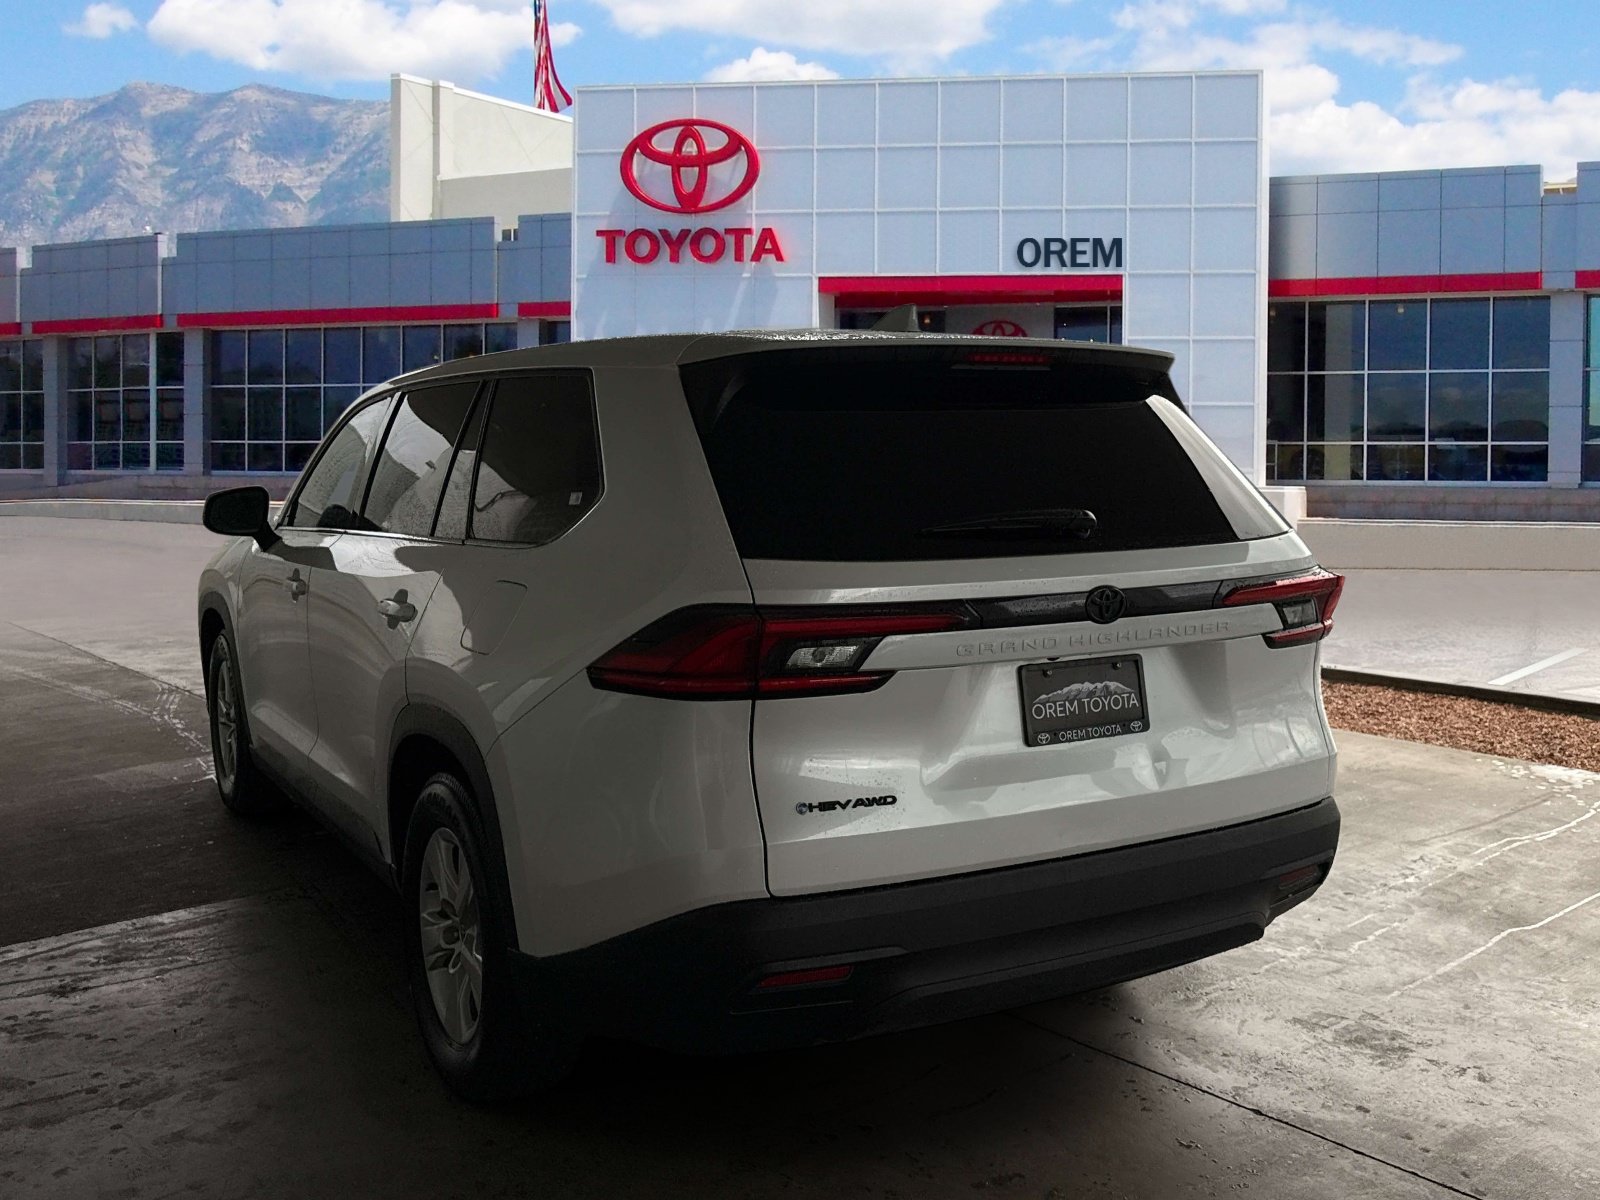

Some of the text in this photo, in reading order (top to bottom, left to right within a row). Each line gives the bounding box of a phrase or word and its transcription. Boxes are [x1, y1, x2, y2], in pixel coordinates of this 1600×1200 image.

[596, 228, 784, 263] TOYOTA
[1016, 237, 1123, 268] OREM
[956, 620, 1230, 657] GRAND HIGHLANDER
[1032, 693, 1139, 719] OREM TOYOTA
[1059, 724, 1122, 741] OREM TOYOTA
[852, 795, 897, 808] AWD
